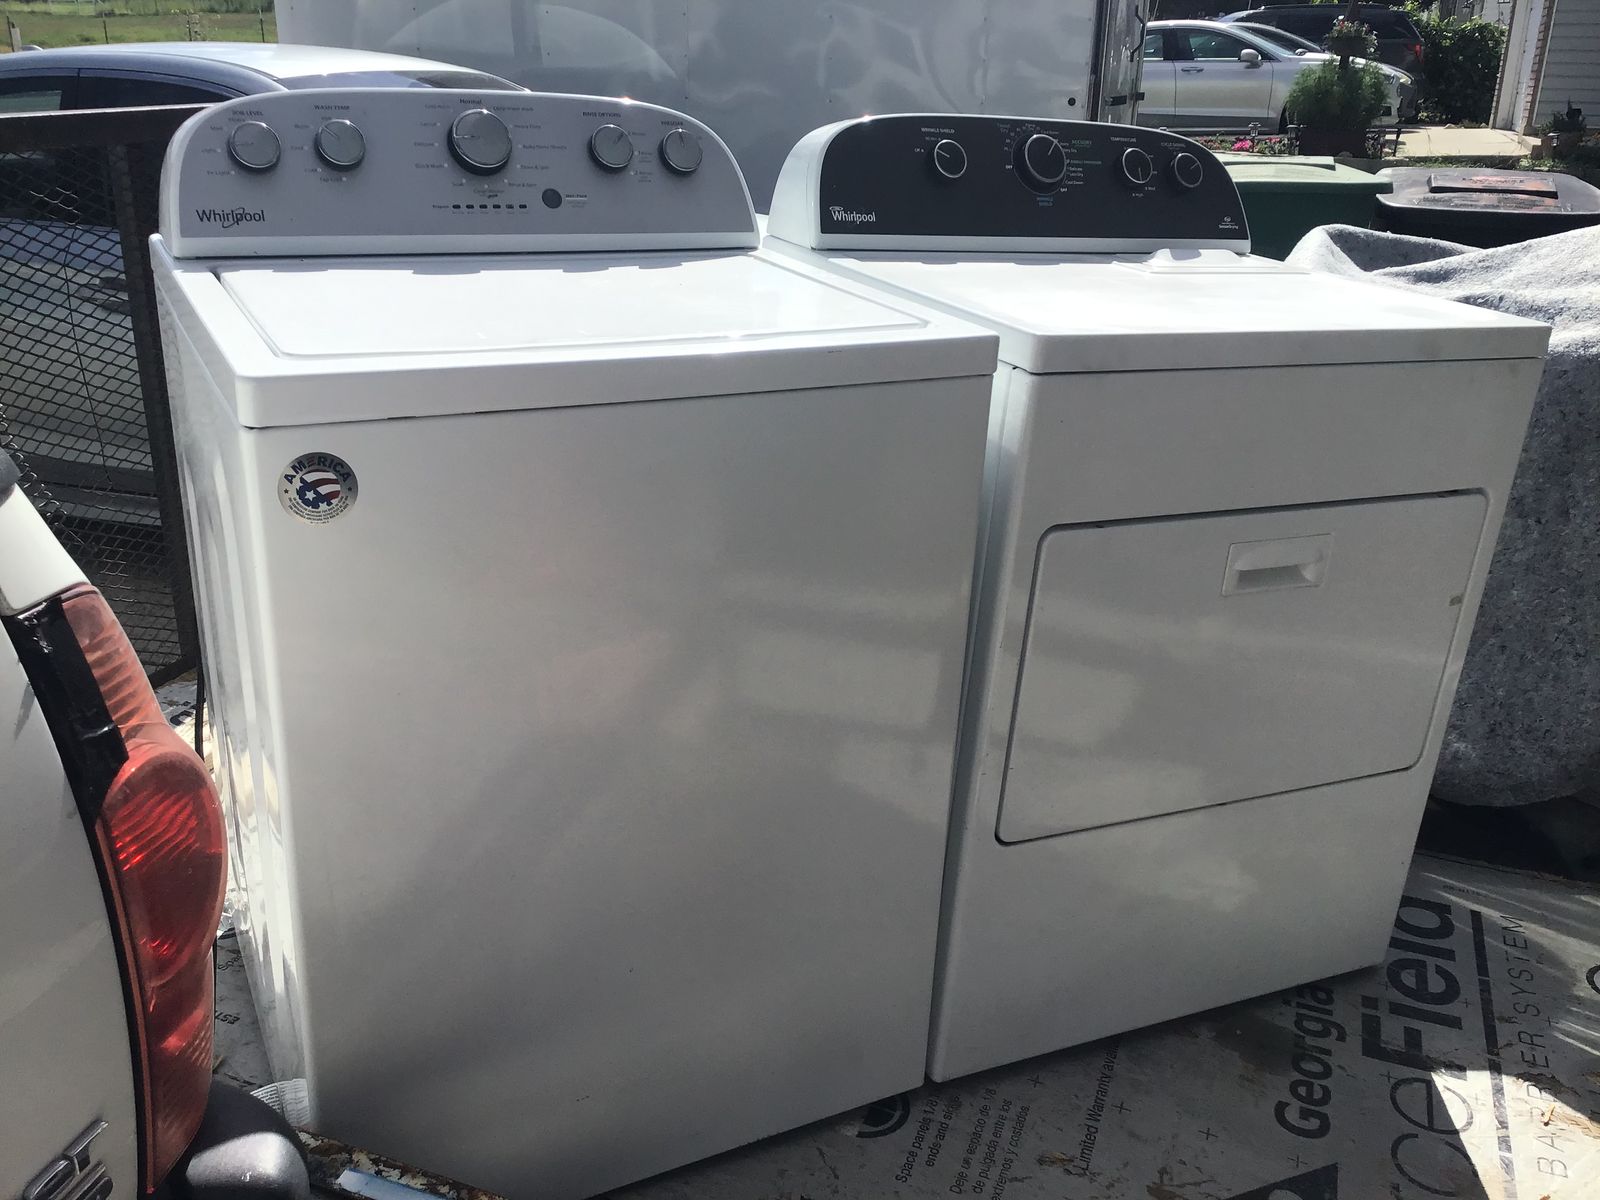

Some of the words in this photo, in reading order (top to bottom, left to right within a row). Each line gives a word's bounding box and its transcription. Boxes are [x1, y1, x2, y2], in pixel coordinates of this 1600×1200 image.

[196, 207, 265, 228] Whirlpool
[830, 208, 876, 225] Whirlpool
[284, 456, 351, 484] AMERICA
[1500, 914, 1540, 1021] SYSTEM
[1274, 984, 1346, 1139] Georgia
[1085, 1073, 1112, 1121] Warranty
[895, 1150, 918, 1183] Space
